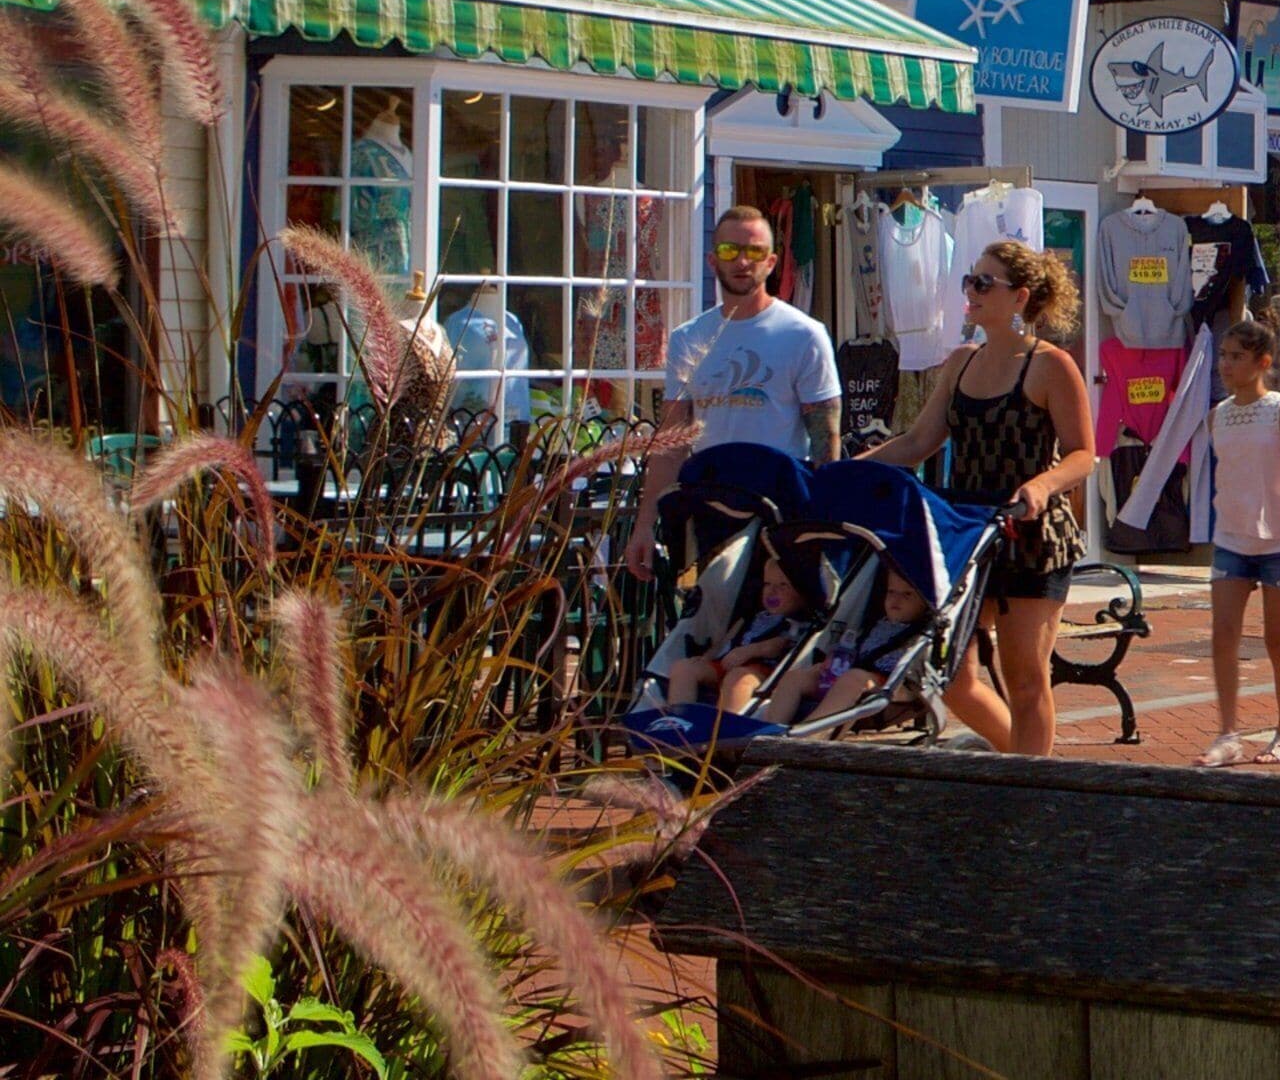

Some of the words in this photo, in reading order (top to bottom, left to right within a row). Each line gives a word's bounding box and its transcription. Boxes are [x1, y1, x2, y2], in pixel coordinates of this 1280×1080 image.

[1112, 24, 1145, 48] GREAT
[1149, 19, 1182, 31] WHITE
[1185, 22, 1220, 47] SHARK
[991, 47, 1065, 71] BOUTIQUE
[974, 70, 1050, 94] ORTWEAR
[1119, 112, 1150, 129] CAPE
